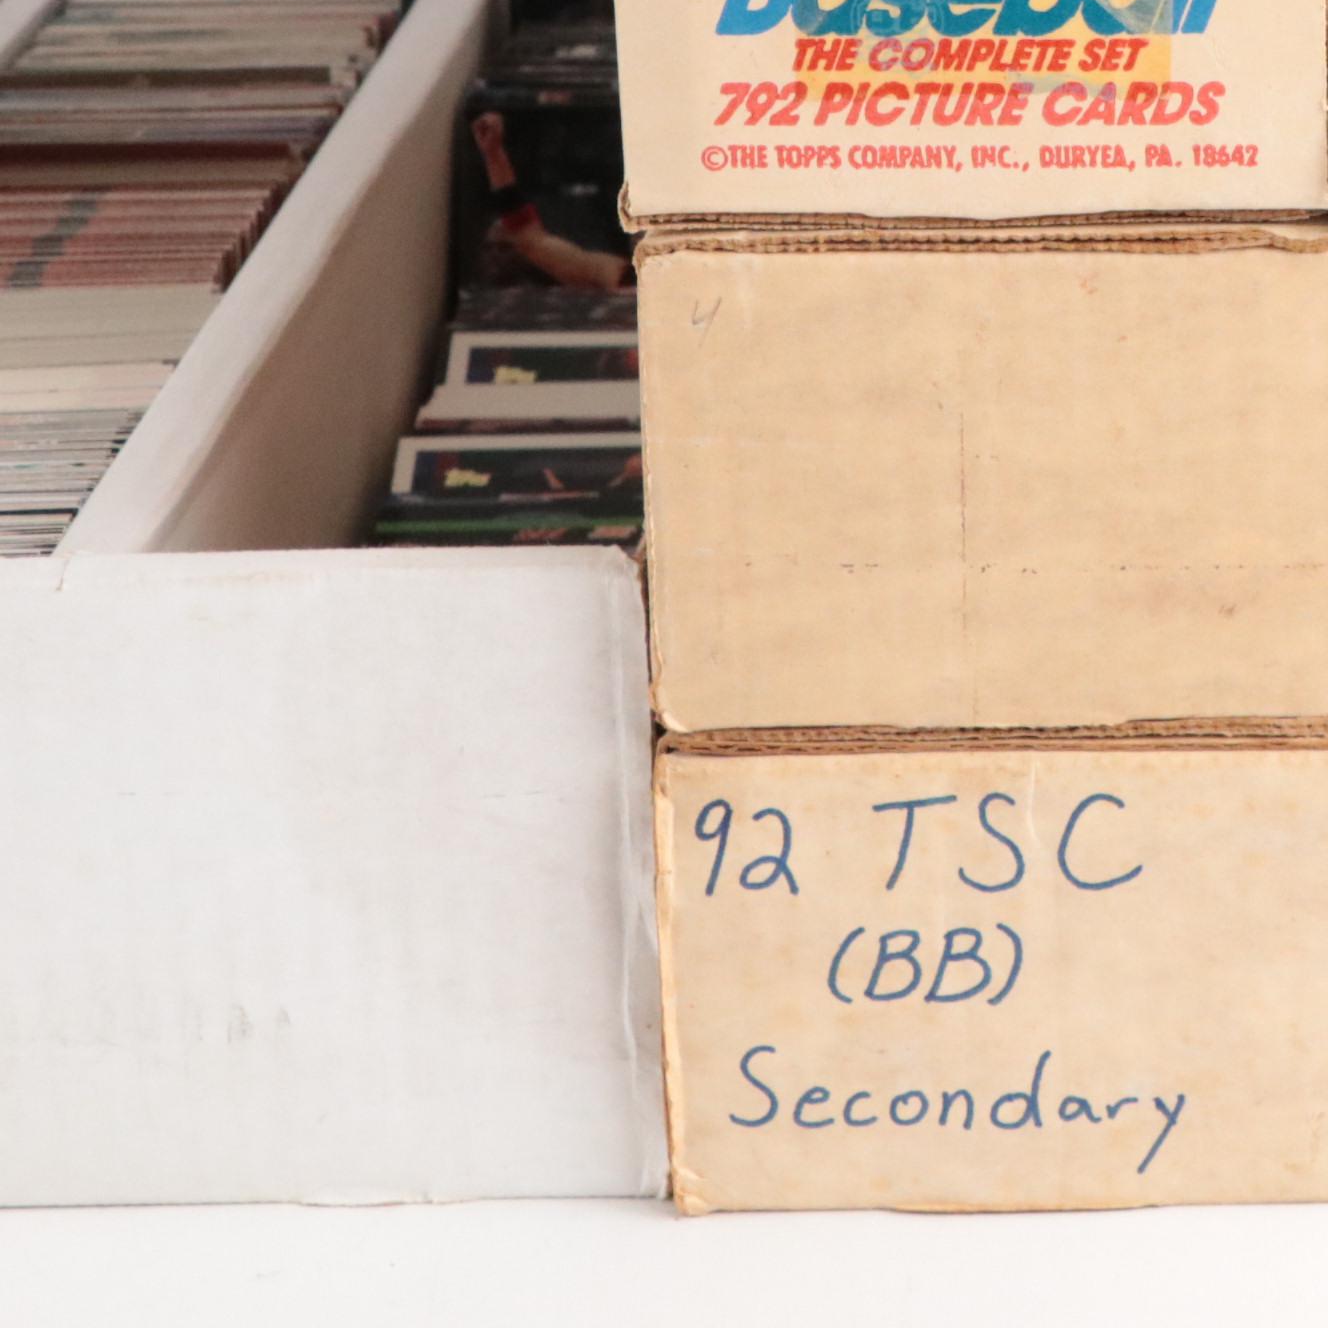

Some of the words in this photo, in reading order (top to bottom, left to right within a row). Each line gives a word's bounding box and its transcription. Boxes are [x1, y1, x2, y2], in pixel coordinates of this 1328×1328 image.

[792, 38, 862, 72] THE
[867, 37, 1077, 72] COMPLETE
[1077, 38, 1150, 72] SET
[713, 80, 809, 127] 792
[813, 81, 1036, 127] PICTURE
[1041, 80, 1227, 127] CARDS
[773, 144, 842, 170] TOPPS
[848, 144, 964, 172] COMPANY,
[971, 143, 1030, 172] INC.,
[1039, 143, 1137, 172] DURYEA,
[1144, 143, 1183, 168] PA.
[1192, 143, 1260, 168] 18642
[693, 798, 801, 896] 92
[870, 791, 1145, 893] TSC
[826, 921, 1024, 1007] (BB)
[728, 1044, 1187, 1175] Secondary
